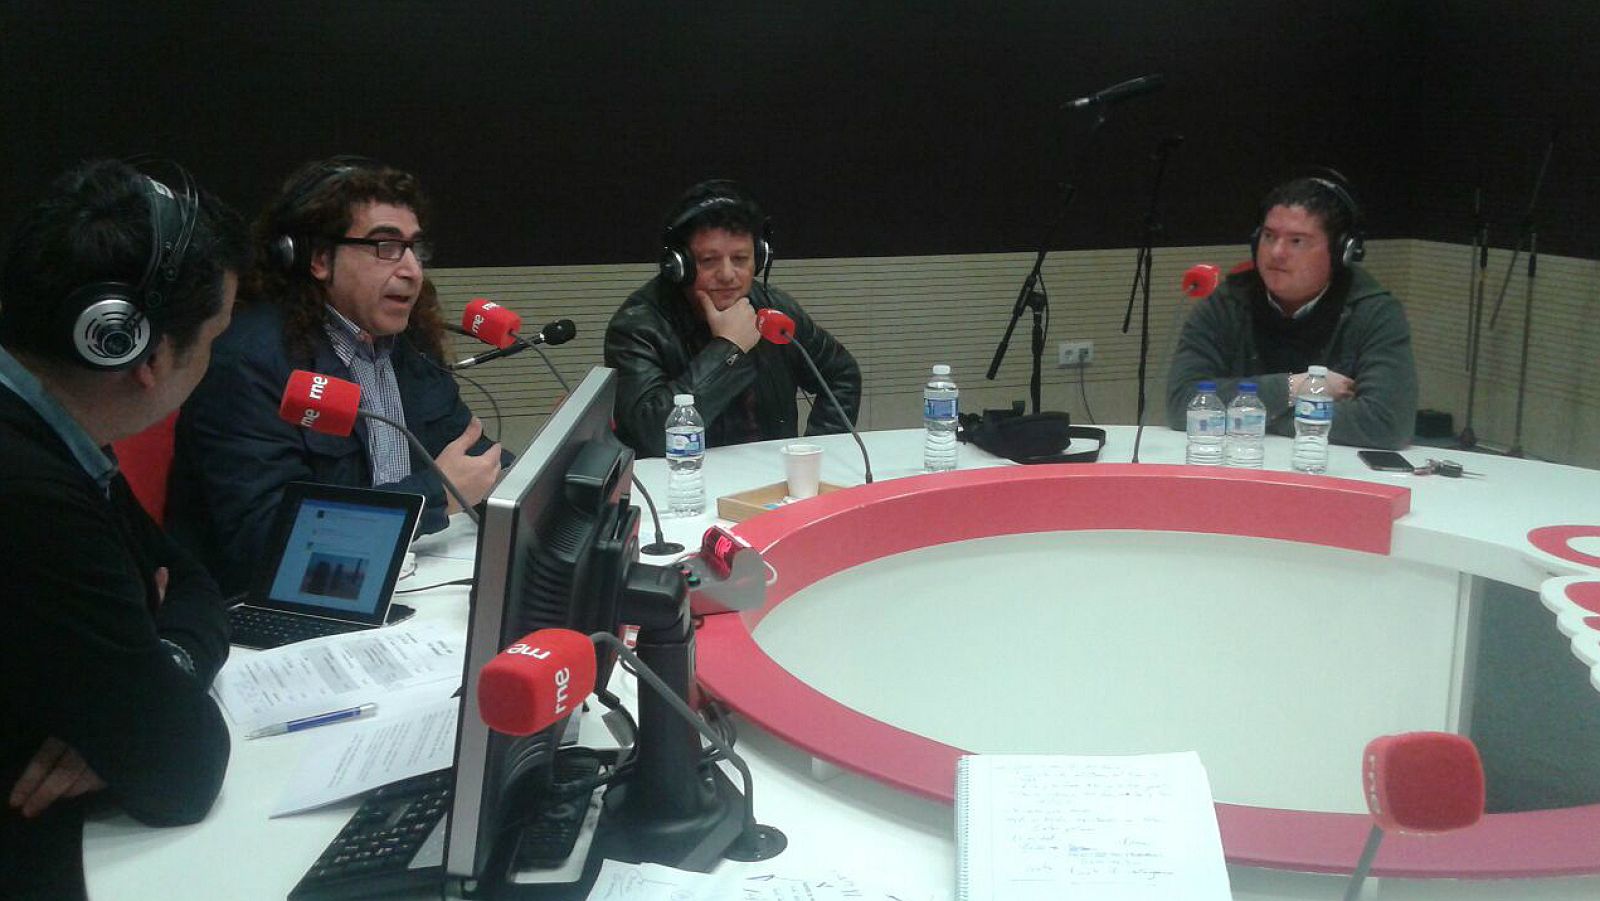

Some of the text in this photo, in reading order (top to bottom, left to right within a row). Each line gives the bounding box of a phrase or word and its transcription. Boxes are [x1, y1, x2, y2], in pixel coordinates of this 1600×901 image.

[471, 314, 484, 334] rne
[309, 376, 328, 400] rne
[300, 408, 321, 428] rne
[507, 643, 551, 660] rne
[554, 667, 571, 715] rne
